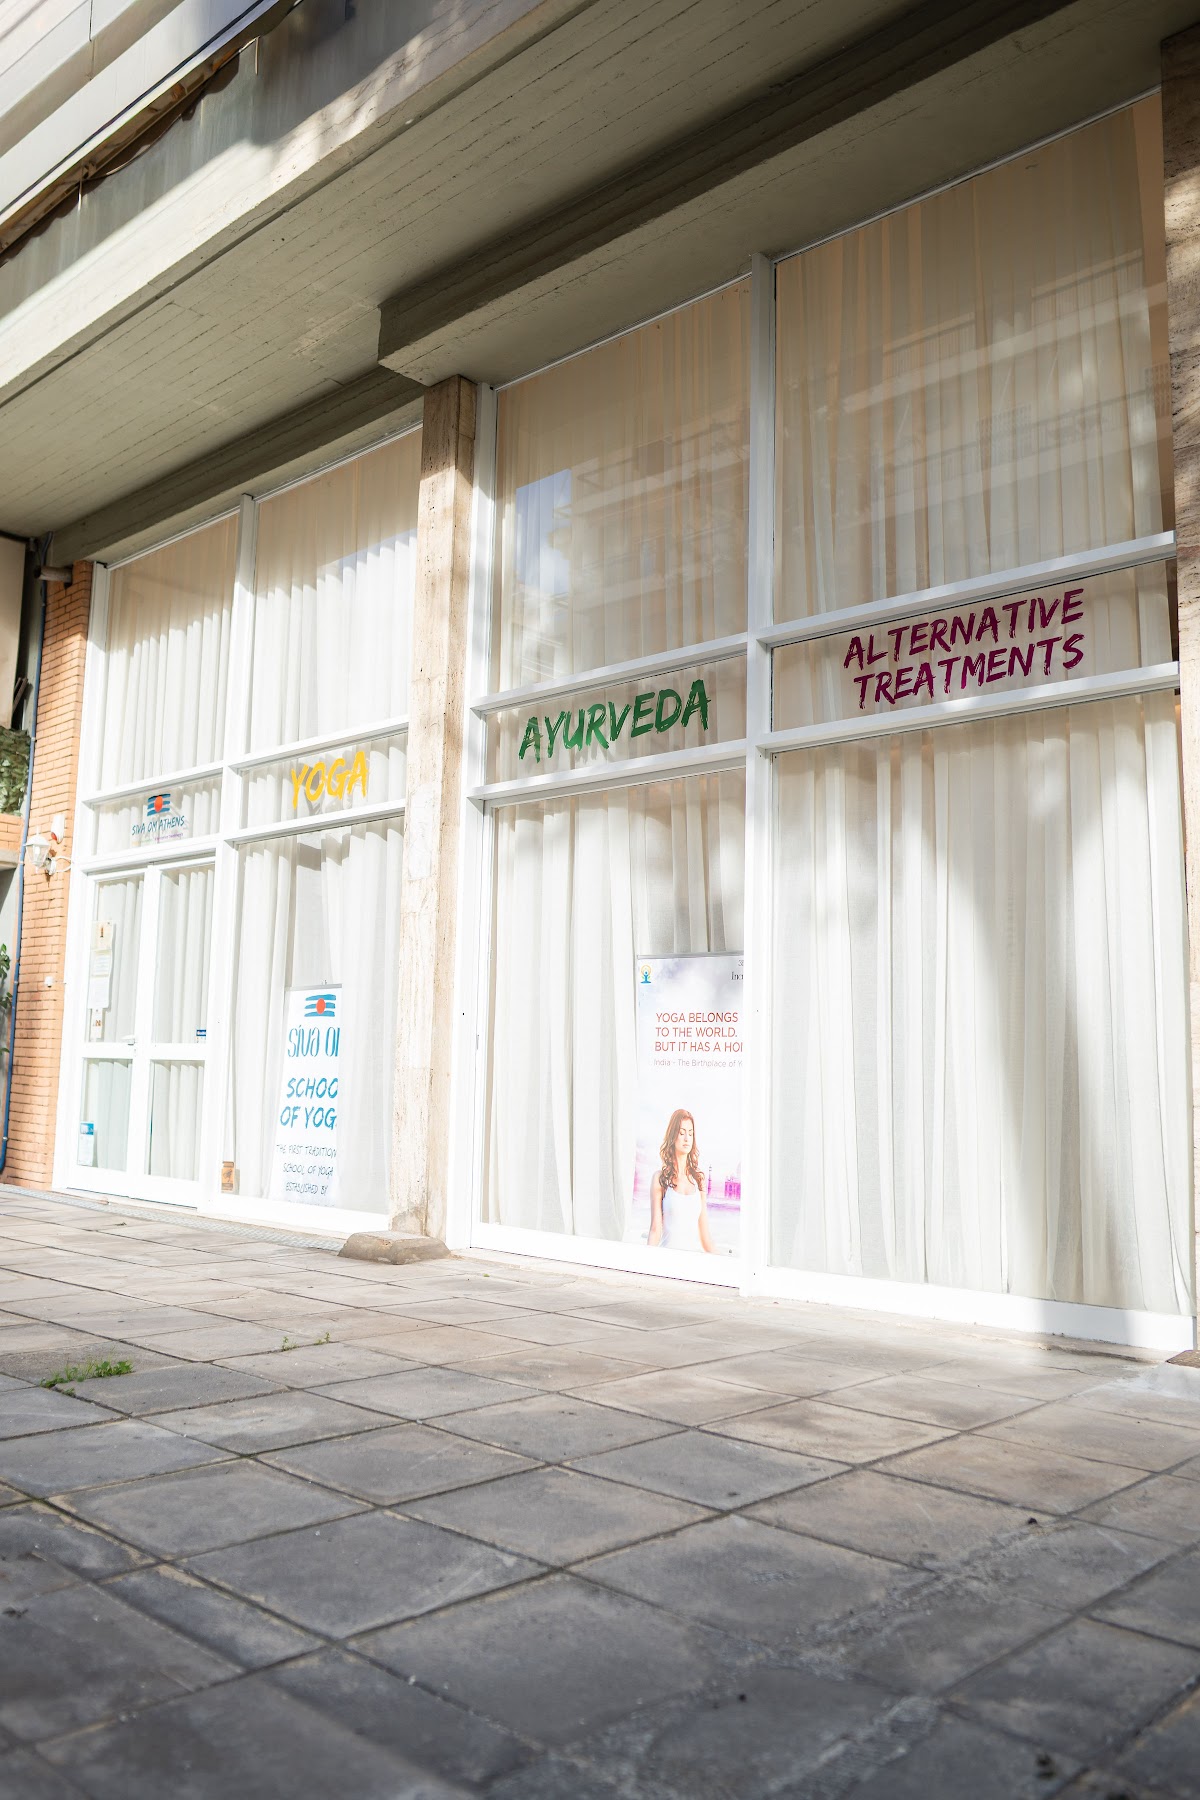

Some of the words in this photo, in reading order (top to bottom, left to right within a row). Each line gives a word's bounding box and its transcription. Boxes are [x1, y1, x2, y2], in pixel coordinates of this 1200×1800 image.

[843, 588, 1085, 669] ALTERNATIVE
[853, 634, 1085, 709] TREATMENTS
[518, 679, 711, 763] AYURVEDA
[290, 750, 369, 810] YOGA
[131, 822, 146, 836] SIVA
[159, 815, 185, 831] ATHENS
[655, 1012, 686, 1023] YOGA
[688, 1012, 739, 1023] BELONGS
[655, 1027, 670, 1038] TO
[672, 1027, 692, 1038] THE
[695, 1027, 738, 1038] WORLD.
[654, 1041, 676, 1052] BUT
[678, 1041, 688, 1052] IT
[690, 1041, 711, 1052] HAS
[713, 1042, 721, 1052] A
[653, 1059, 671, 1067] India
[677, 1059, 690, 1067] The
[691, 1059, 727, 1068] Birthplace
[728, 1060, 737, 1068] of
[280, 1106, 301, 1129] OF
[304, 1107, 337, 1130] YOG
[276, 1144, 287, 1154] THE
[288, 1144, 303, 1155] FIRST
[282, 1162, 305, 1175] SCHOOL
[307, 1165, 316, 1174] OF
[317, 1165, 333, 1179] YOGA
[320, 1184, 328, 1196] BY
